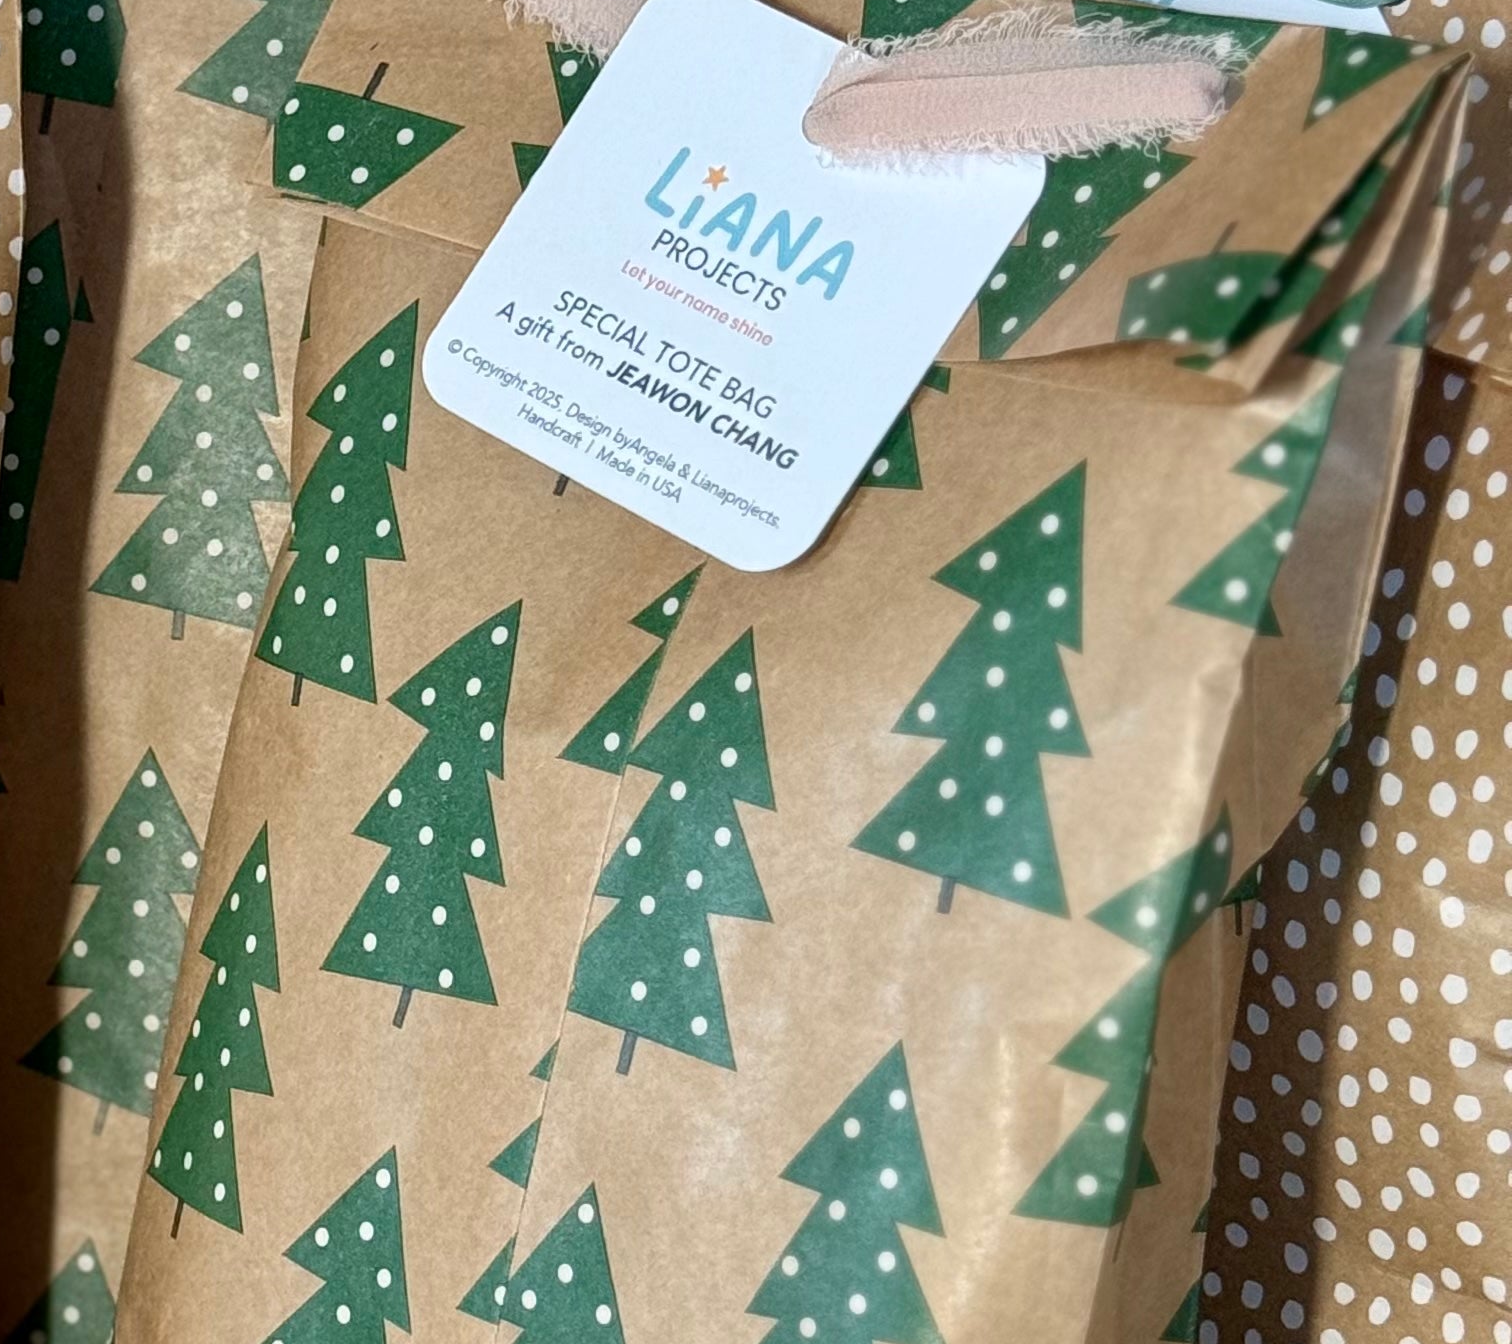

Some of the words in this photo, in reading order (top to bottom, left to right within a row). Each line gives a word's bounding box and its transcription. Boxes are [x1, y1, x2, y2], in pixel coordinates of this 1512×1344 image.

[620, 259, 645, 282] Let
[644, 273, 683, 300] your
[682, 292, 730, 325] name
[731, 318, 774, 347] shine
[651, 228, 787, 311] PROJECTS
[495, 301, 514, 324] A
[514, 307, 556, 344] gift
[556, 329, 605, 371] from
[606, 360, 712, 424] JEAWON
[710, 413, 800, 470] CHANG
[553, 290, 650, 357] SPECIAL
[655, 340, 722, 392] TOTE
[719, 376, 777, 419] BAG
[463, 347, 529, 391] Copyright
[527, 382, 564, 413] 2025.
[565, 402, 612, 438] Design
[677, 463, 690, 481] &
[517, 402, 585, 450] Handcraft
[596, 445, 636, 478] Made
[636, 465, 649, 484] in
[652, 475, 682, 504] USA
